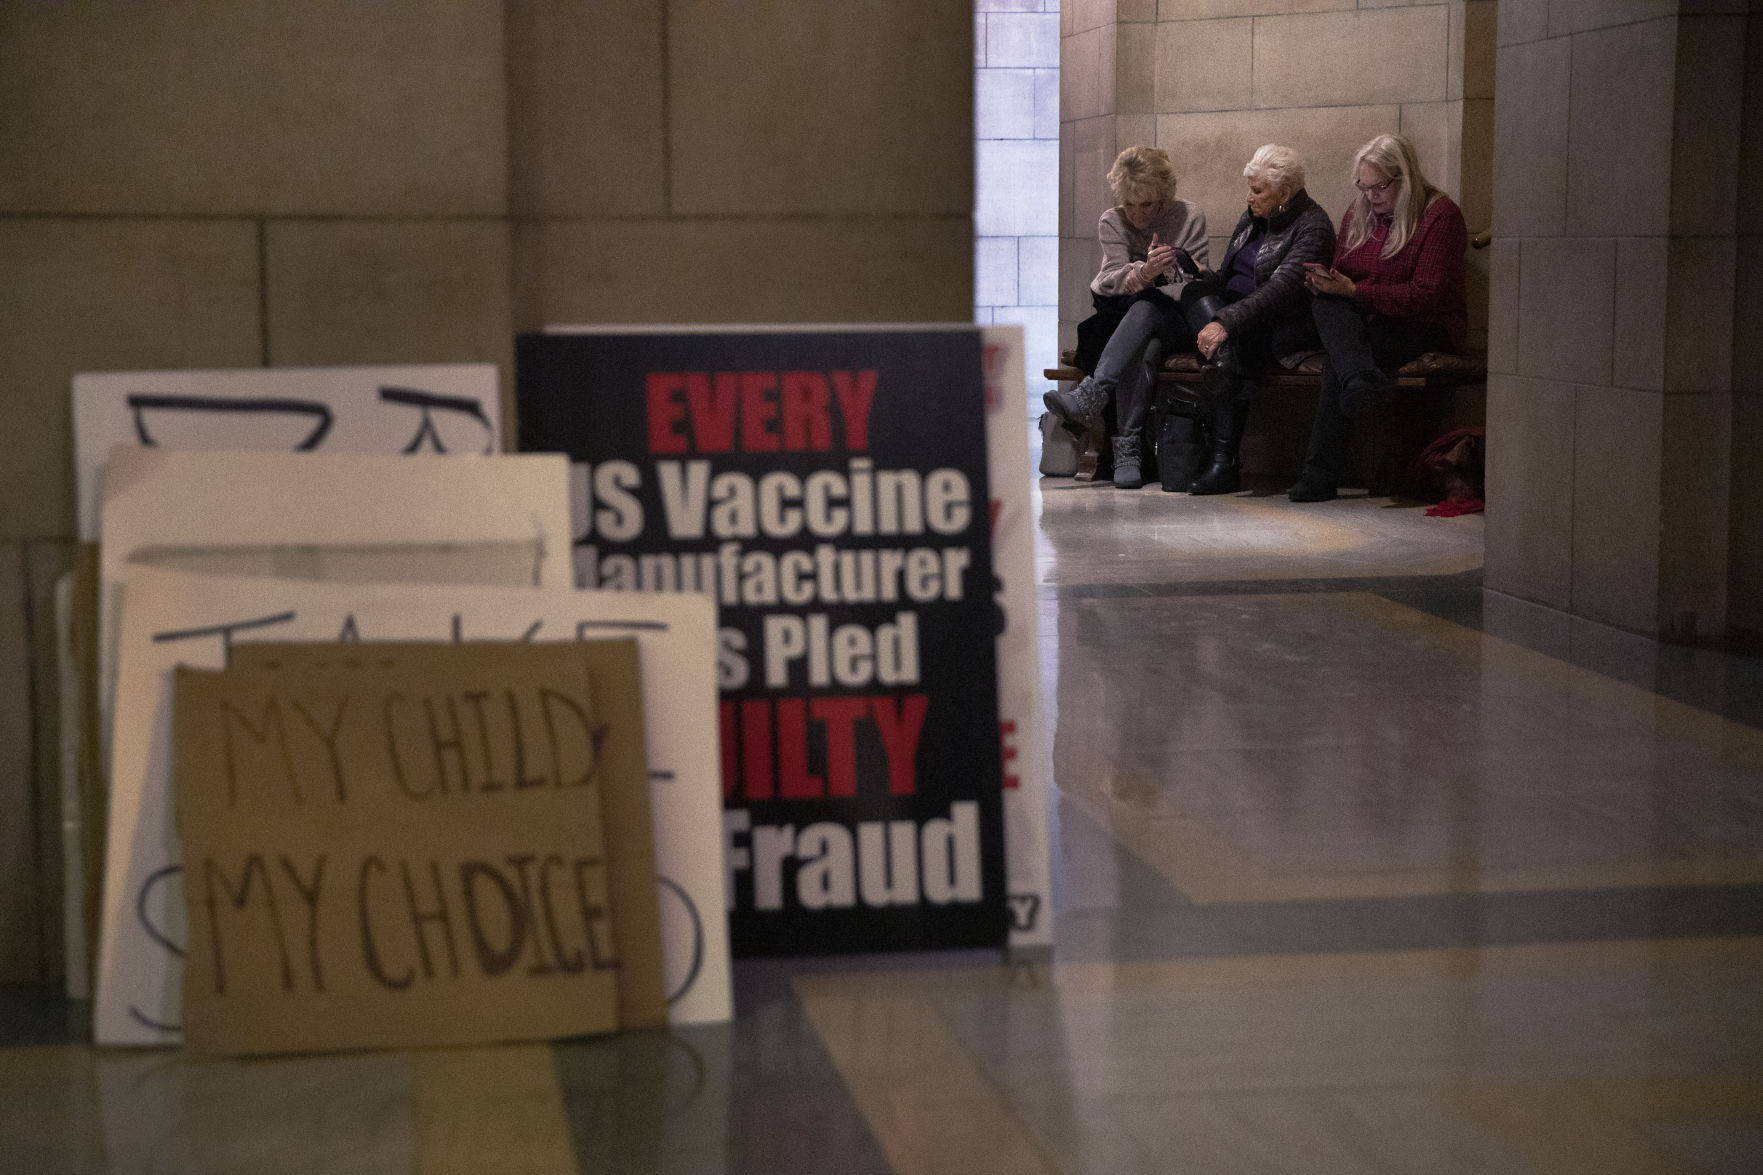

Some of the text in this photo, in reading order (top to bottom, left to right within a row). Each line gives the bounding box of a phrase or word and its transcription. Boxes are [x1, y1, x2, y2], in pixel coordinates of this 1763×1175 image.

[646, 370, 878, 453] EVERY
[656, 458, 971, 540] Vaccine
[763, 610, 920, 689] Pled
[218, 688, 604, 807] MY CHILD
[720, 695, 928, 799] ILTY
[723, 801, 982, 911] Fraud
[204, 852, 329, 998] MY
[358, 852, 624, 991] CHOICE
